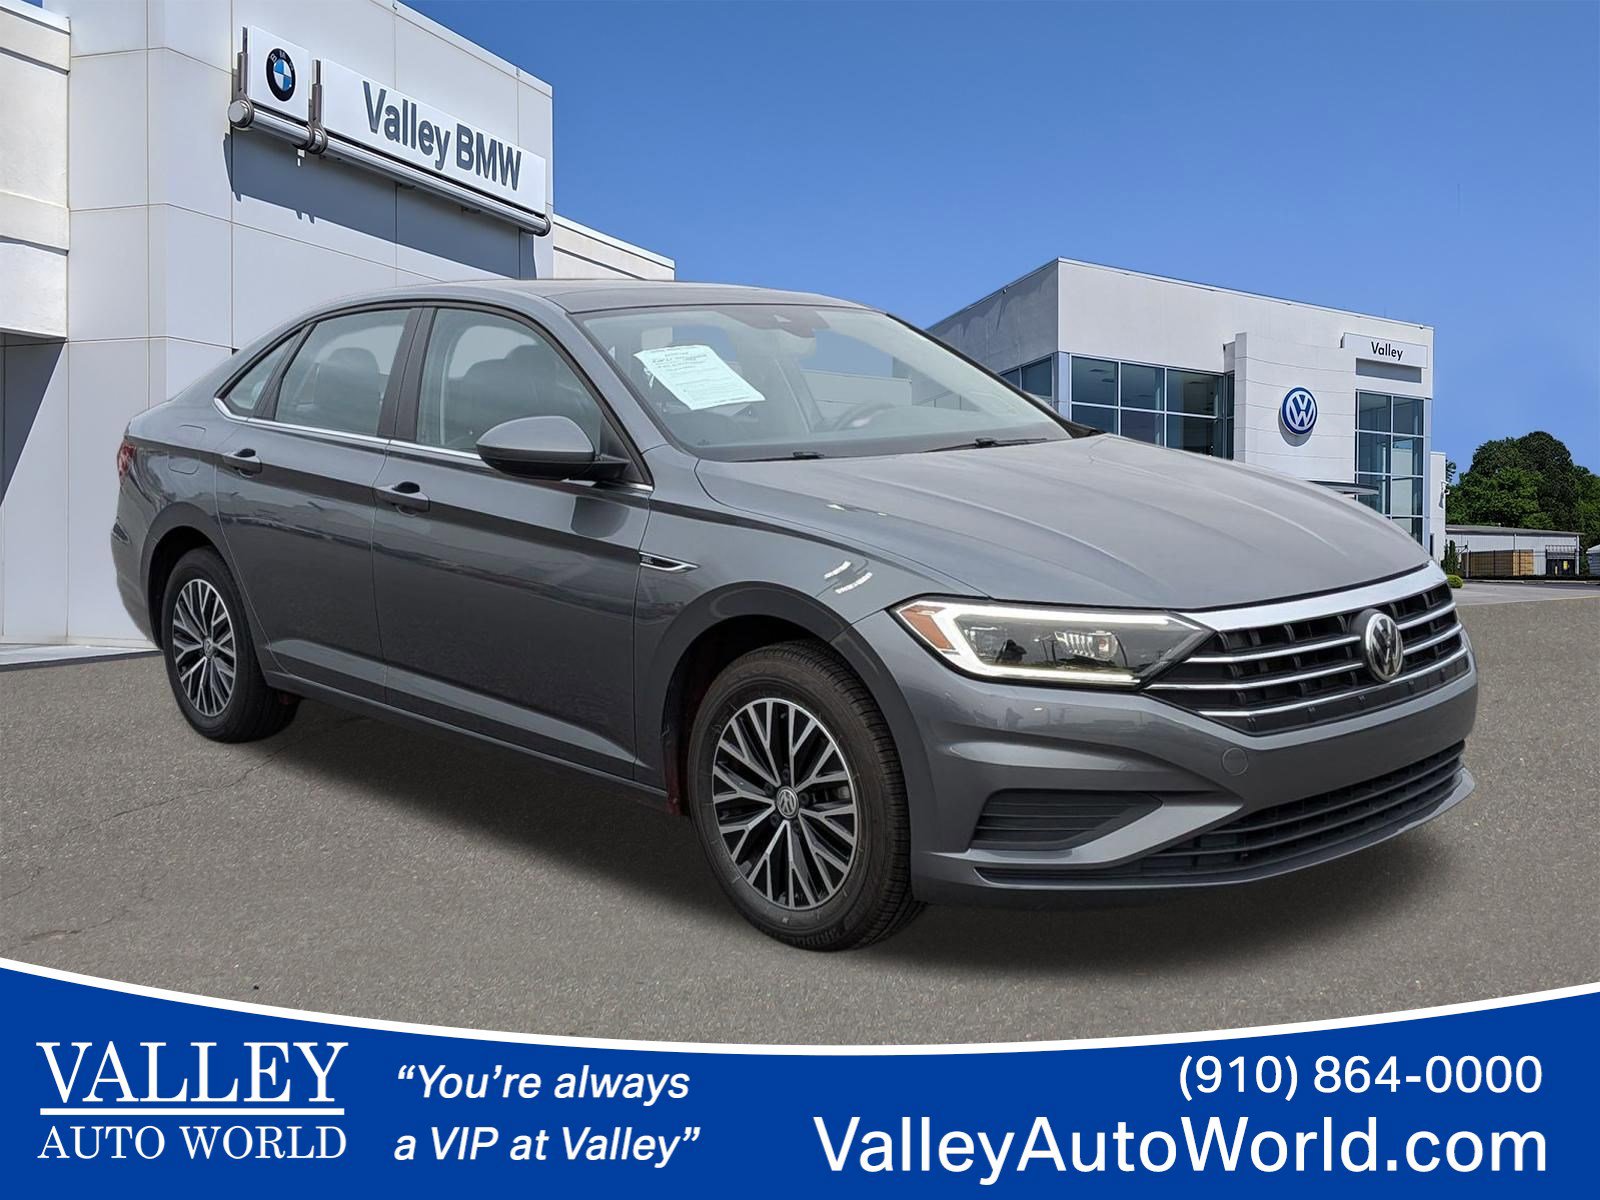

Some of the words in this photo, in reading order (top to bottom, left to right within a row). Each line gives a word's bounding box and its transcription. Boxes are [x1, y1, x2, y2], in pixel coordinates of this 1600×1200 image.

[362, 81, 450, 171] Valley
[456, 123, 522, 191] BMW
[1371, 341, 1403, 361] Valley
